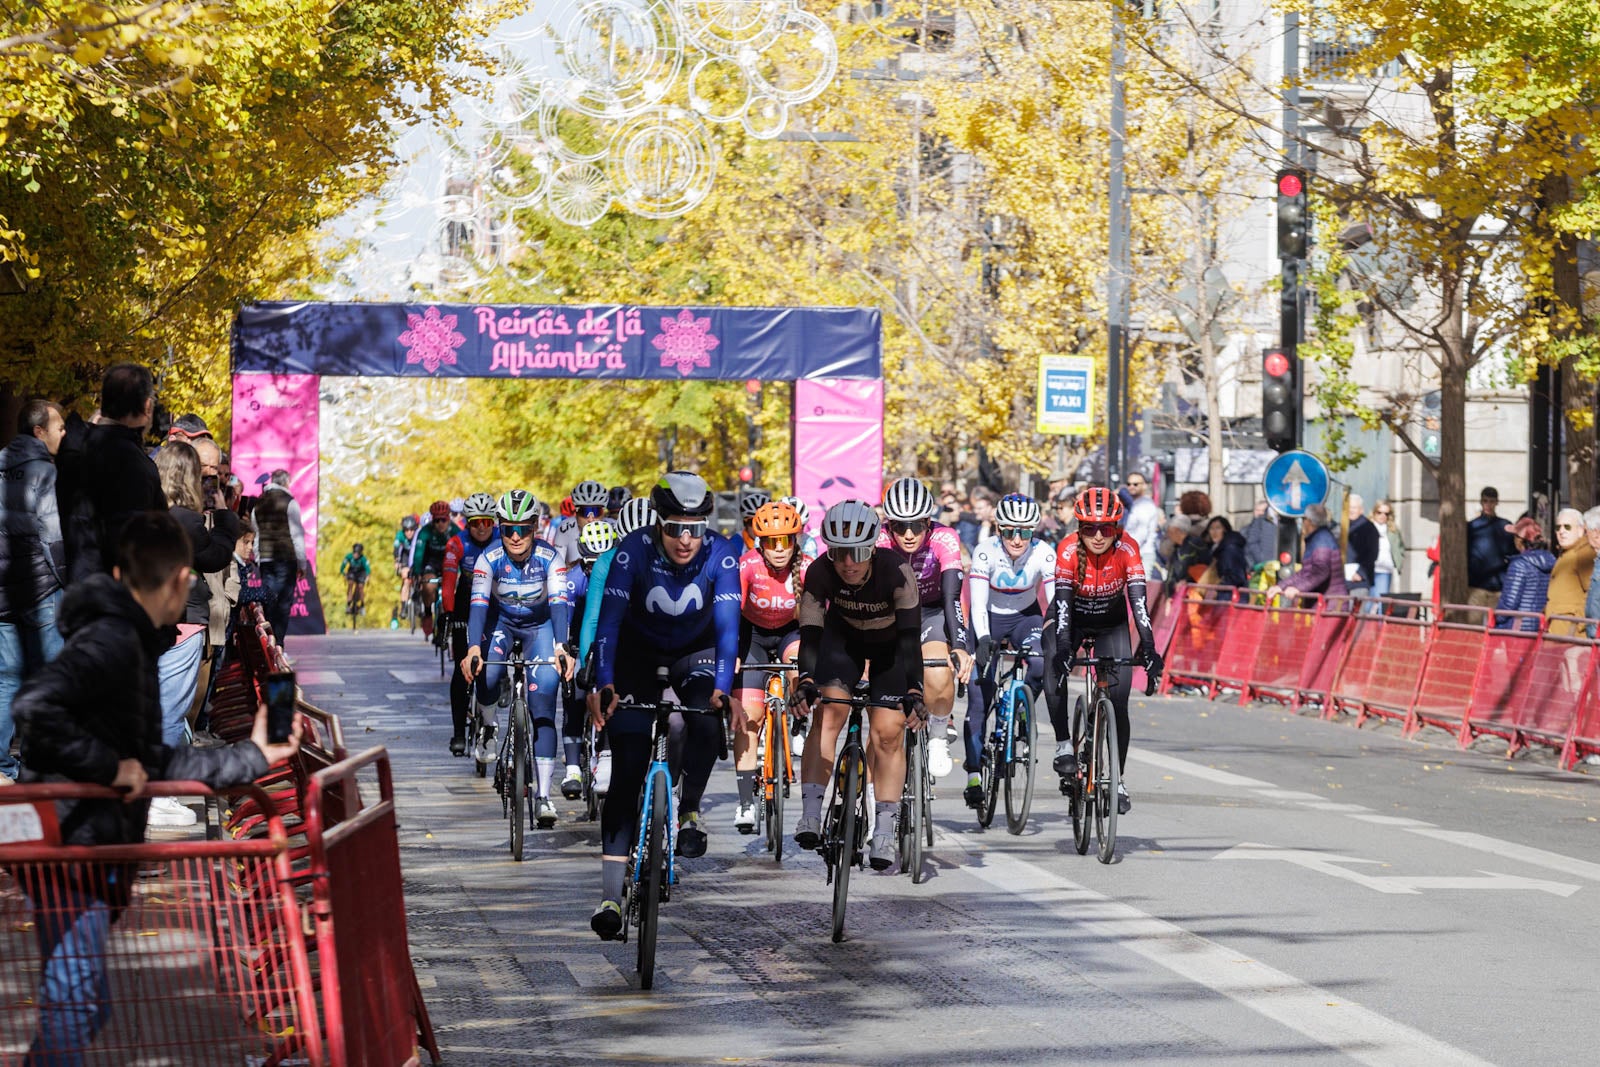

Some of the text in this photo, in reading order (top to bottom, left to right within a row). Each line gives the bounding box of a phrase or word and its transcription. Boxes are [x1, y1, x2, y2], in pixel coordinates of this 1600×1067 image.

[473, 307, 573, 340] Reinäs
[577, 309, 613, 335] de
[1051, 395, 1082, 407] TAXI
[560, 521, 576, 533] Liv
[1079, 578, 1123, 592] ntabria
[834, 597, 889, 613] DISRUPTORS
